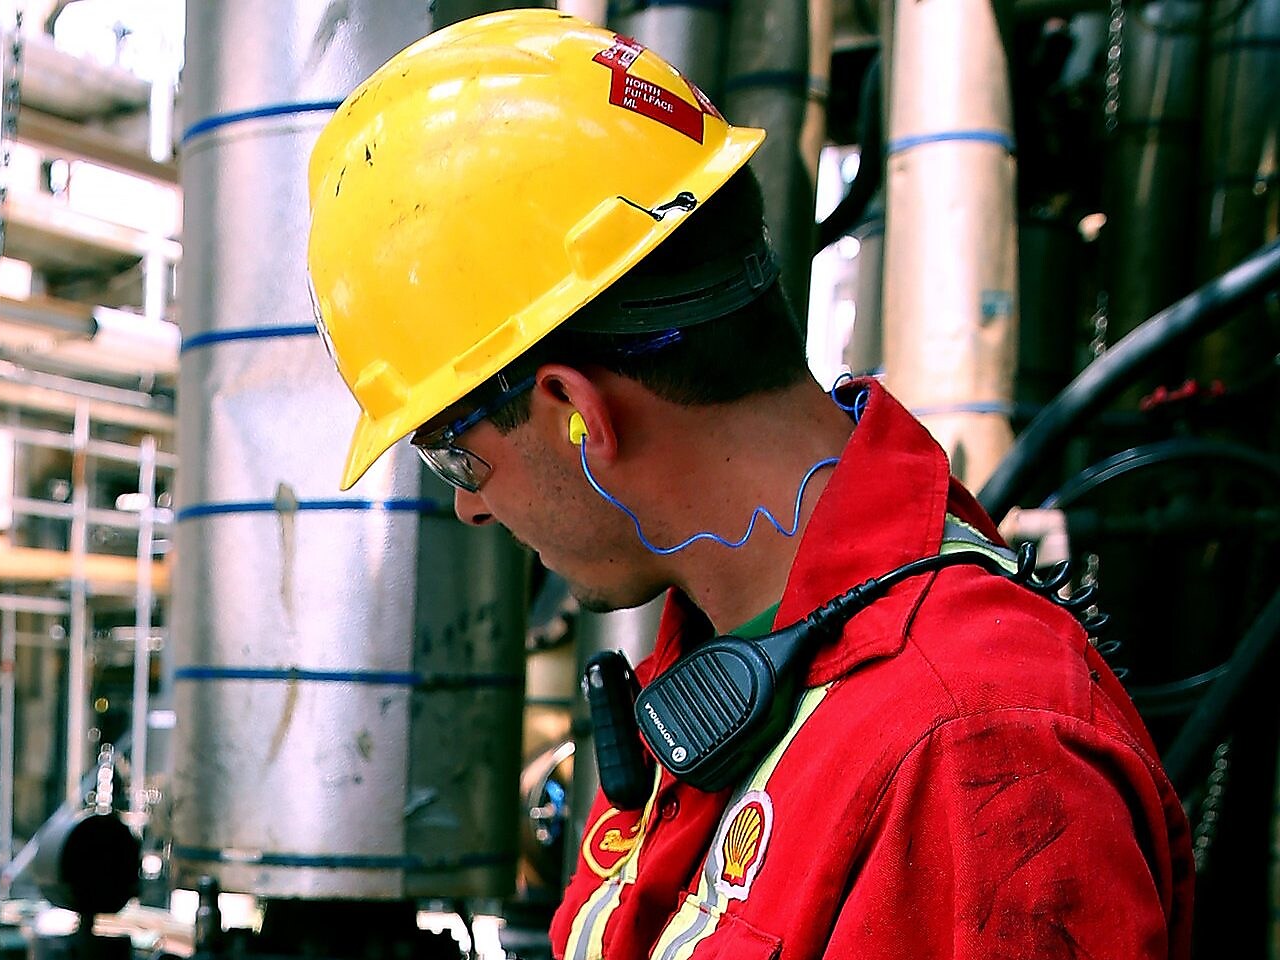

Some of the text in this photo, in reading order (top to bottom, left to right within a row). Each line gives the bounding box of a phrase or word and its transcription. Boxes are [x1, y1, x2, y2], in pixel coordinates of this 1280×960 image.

[625, 77, 661, 97] NORTH
[623, 97, 637, 109] ML
[624, 87, 673, 113] FULLFACE
[644, 702, 676, 747] MOTOROLA
